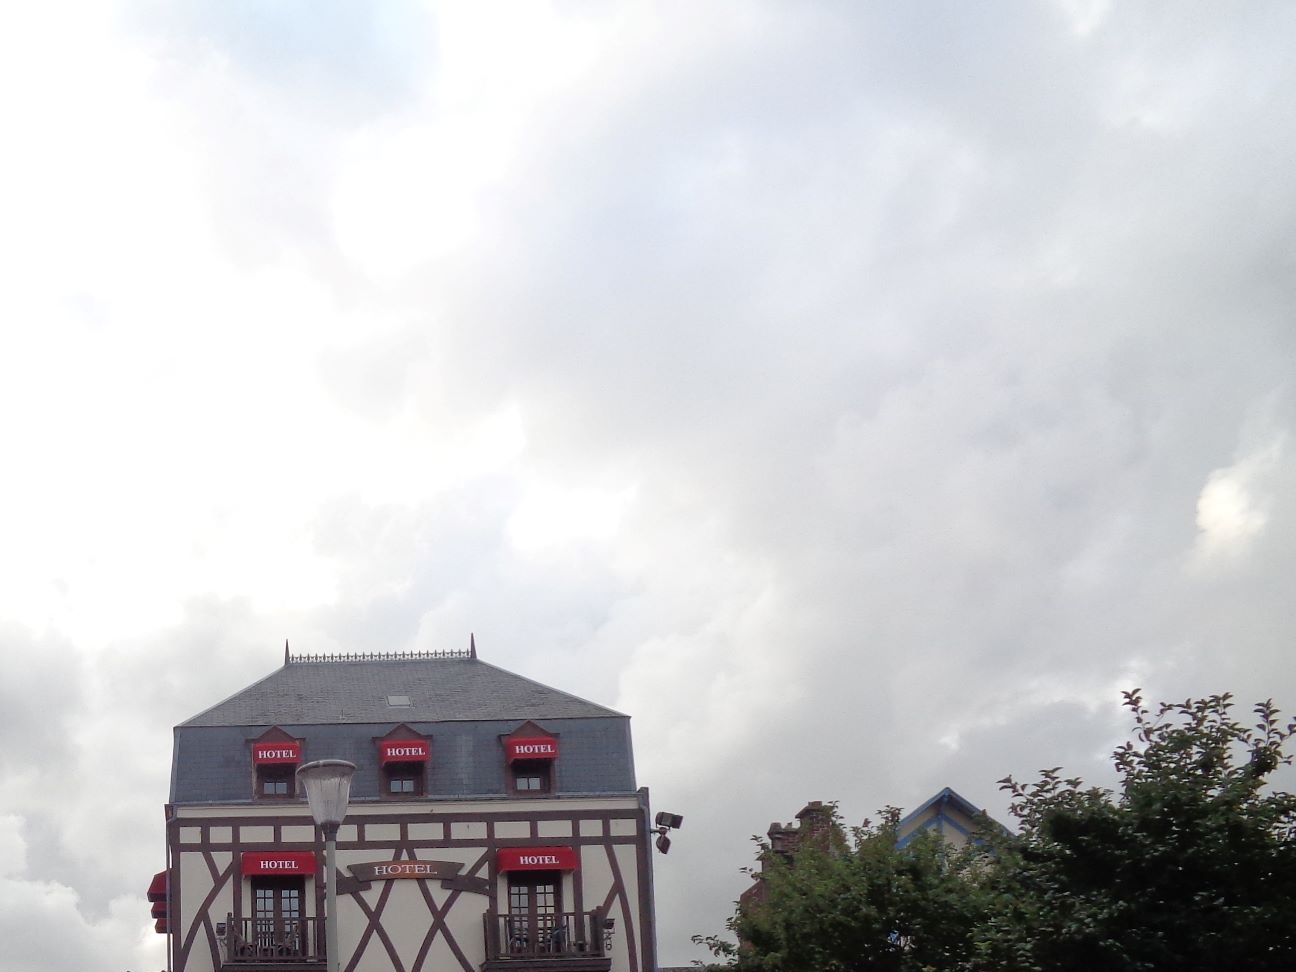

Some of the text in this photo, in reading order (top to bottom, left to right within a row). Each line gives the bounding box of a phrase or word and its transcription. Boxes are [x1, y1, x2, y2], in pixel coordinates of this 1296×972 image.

[258, 749, 297, 759] HOTEL
[387, 747, 426, 757] HOTEL
[516, 744, 555, 754] HOTEL
[260, 859, 299, 870] HOTEL
[520, 855, 560, 865] HOTEL
[374, 864, 438, 876] HOTEL
